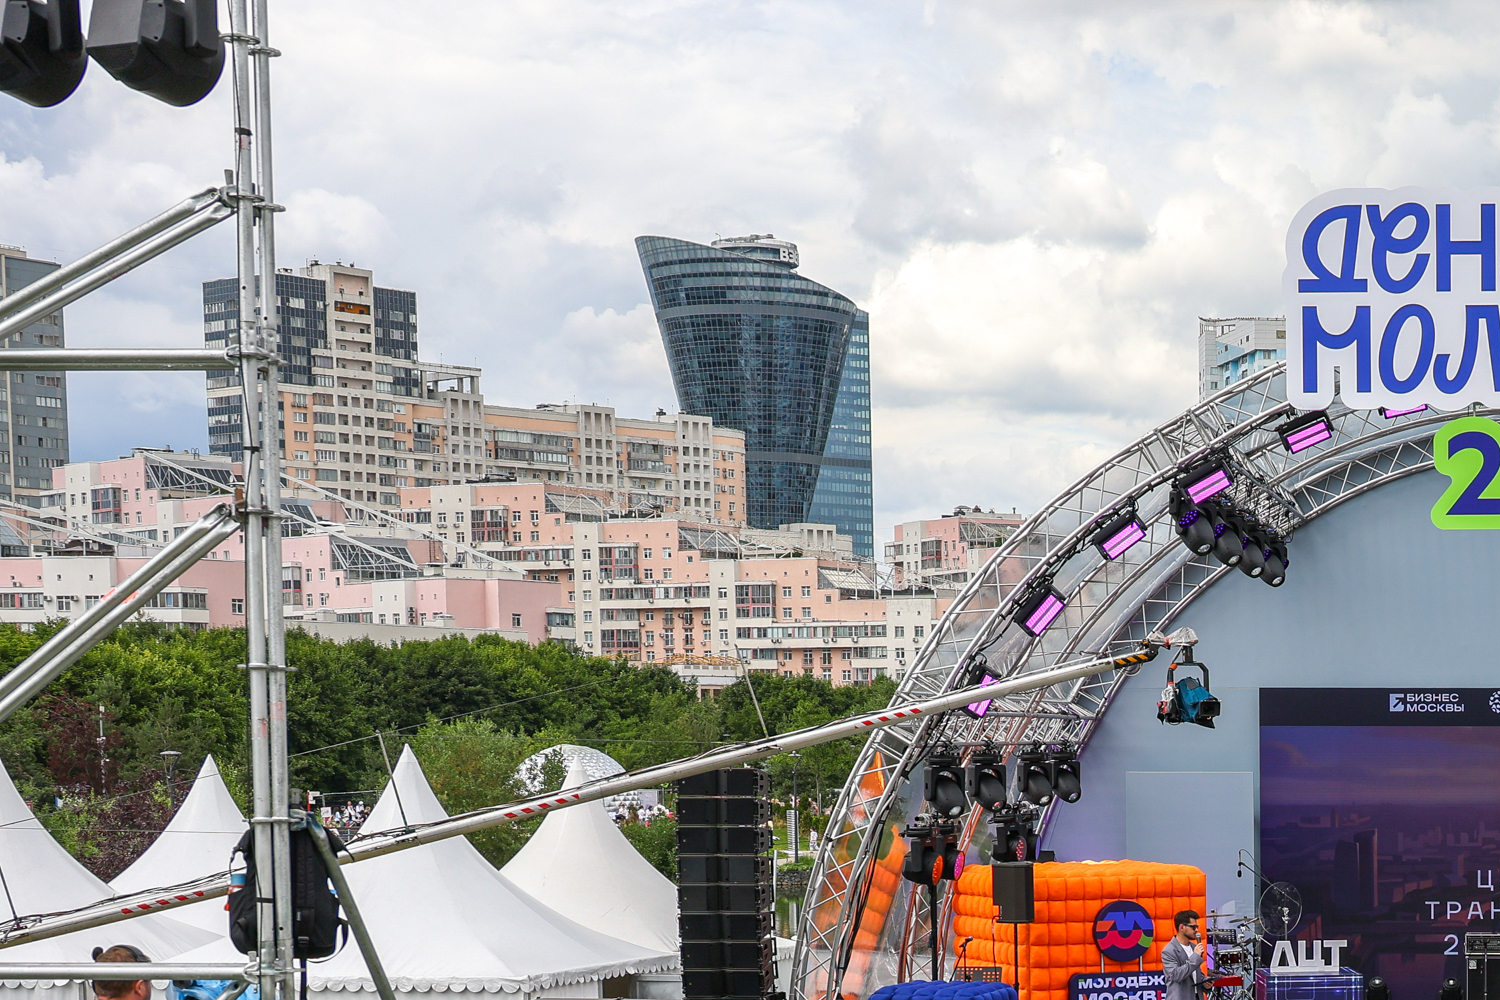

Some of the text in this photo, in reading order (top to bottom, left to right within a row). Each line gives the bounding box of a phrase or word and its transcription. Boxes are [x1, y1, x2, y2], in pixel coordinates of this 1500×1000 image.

[1406, 693, 1459, 702] БИЗНЕС
[1406, 703, 1465, 713] МОСКВЫ
[1078, 972, 1165, 989] МОЛОДЁЖ
